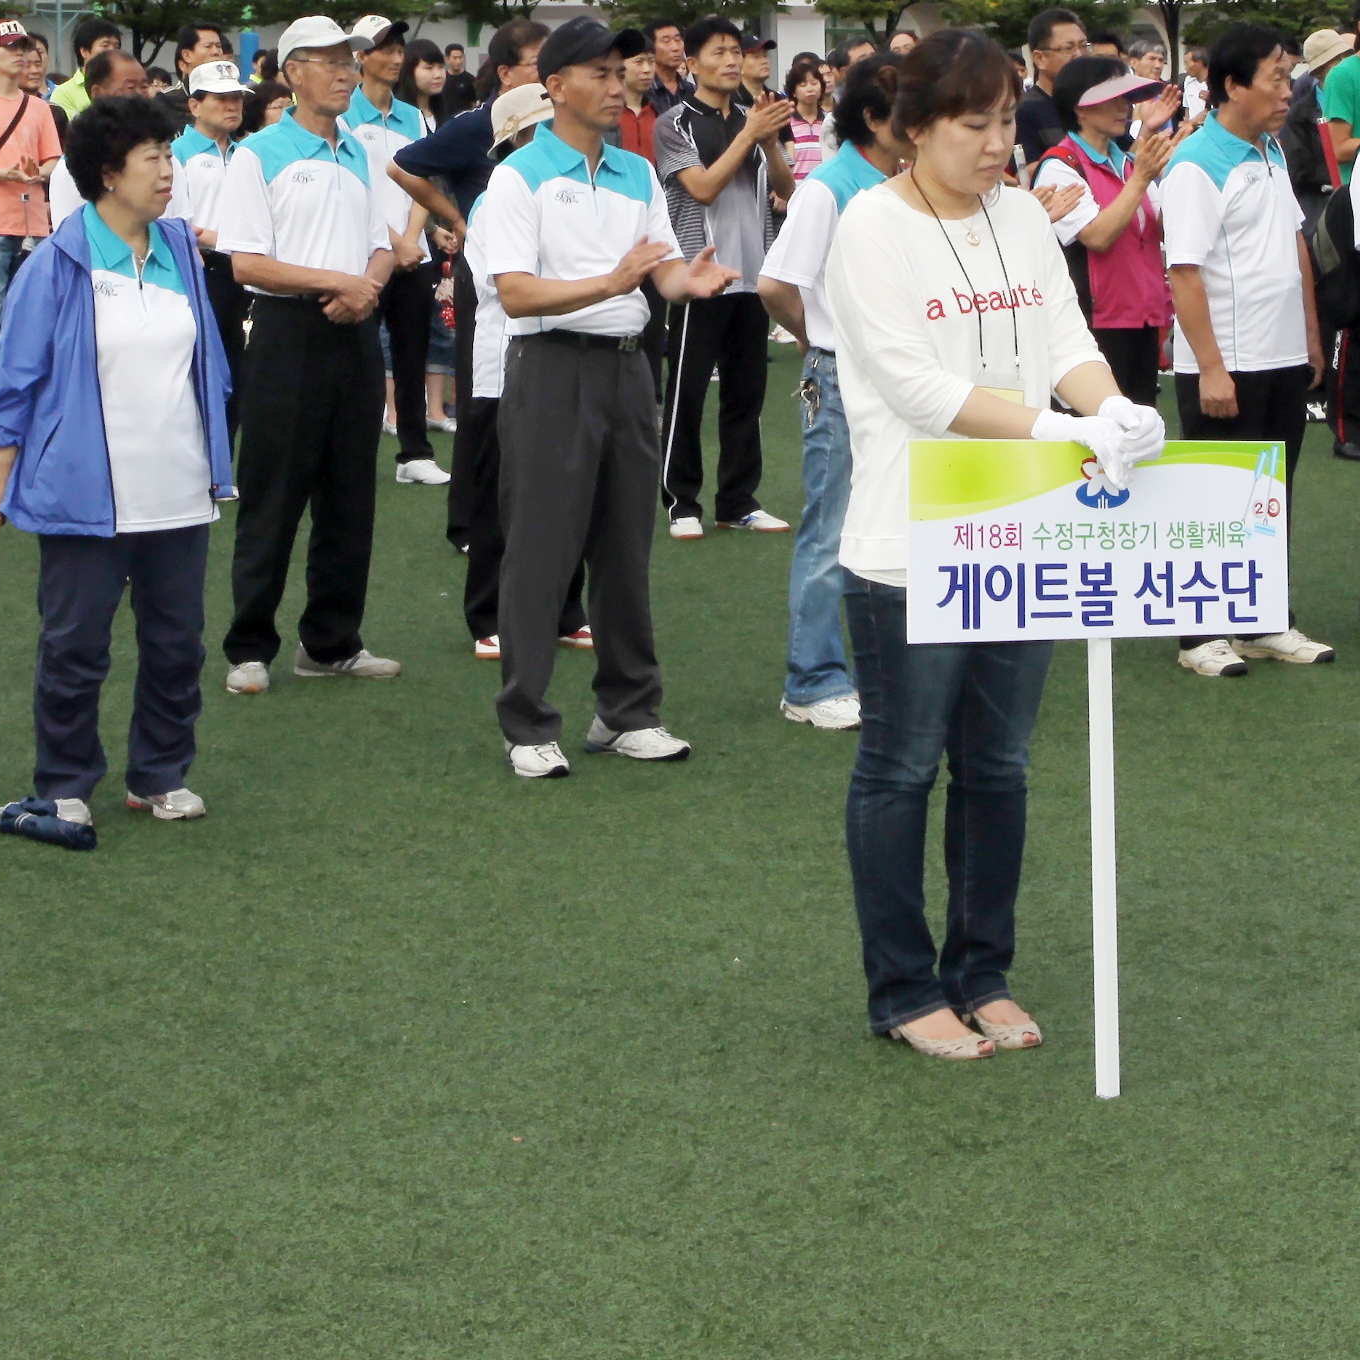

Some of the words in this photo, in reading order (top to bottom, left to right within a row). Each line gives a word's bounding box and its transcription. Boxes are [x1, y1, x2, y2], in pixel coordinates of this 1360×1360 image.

[926, 298, 947, 321] a
[951, 280, 1044, 315] beauté
[953, 521, 1023, 552] 제18회
[1032, 520, 1159, 551] 수정구청장기
[1166, 519, 1247, 550] 생활체육
[936, 561, 1119, 631] 게이트볼
[1134, 559, 1264, 626] 선수단
